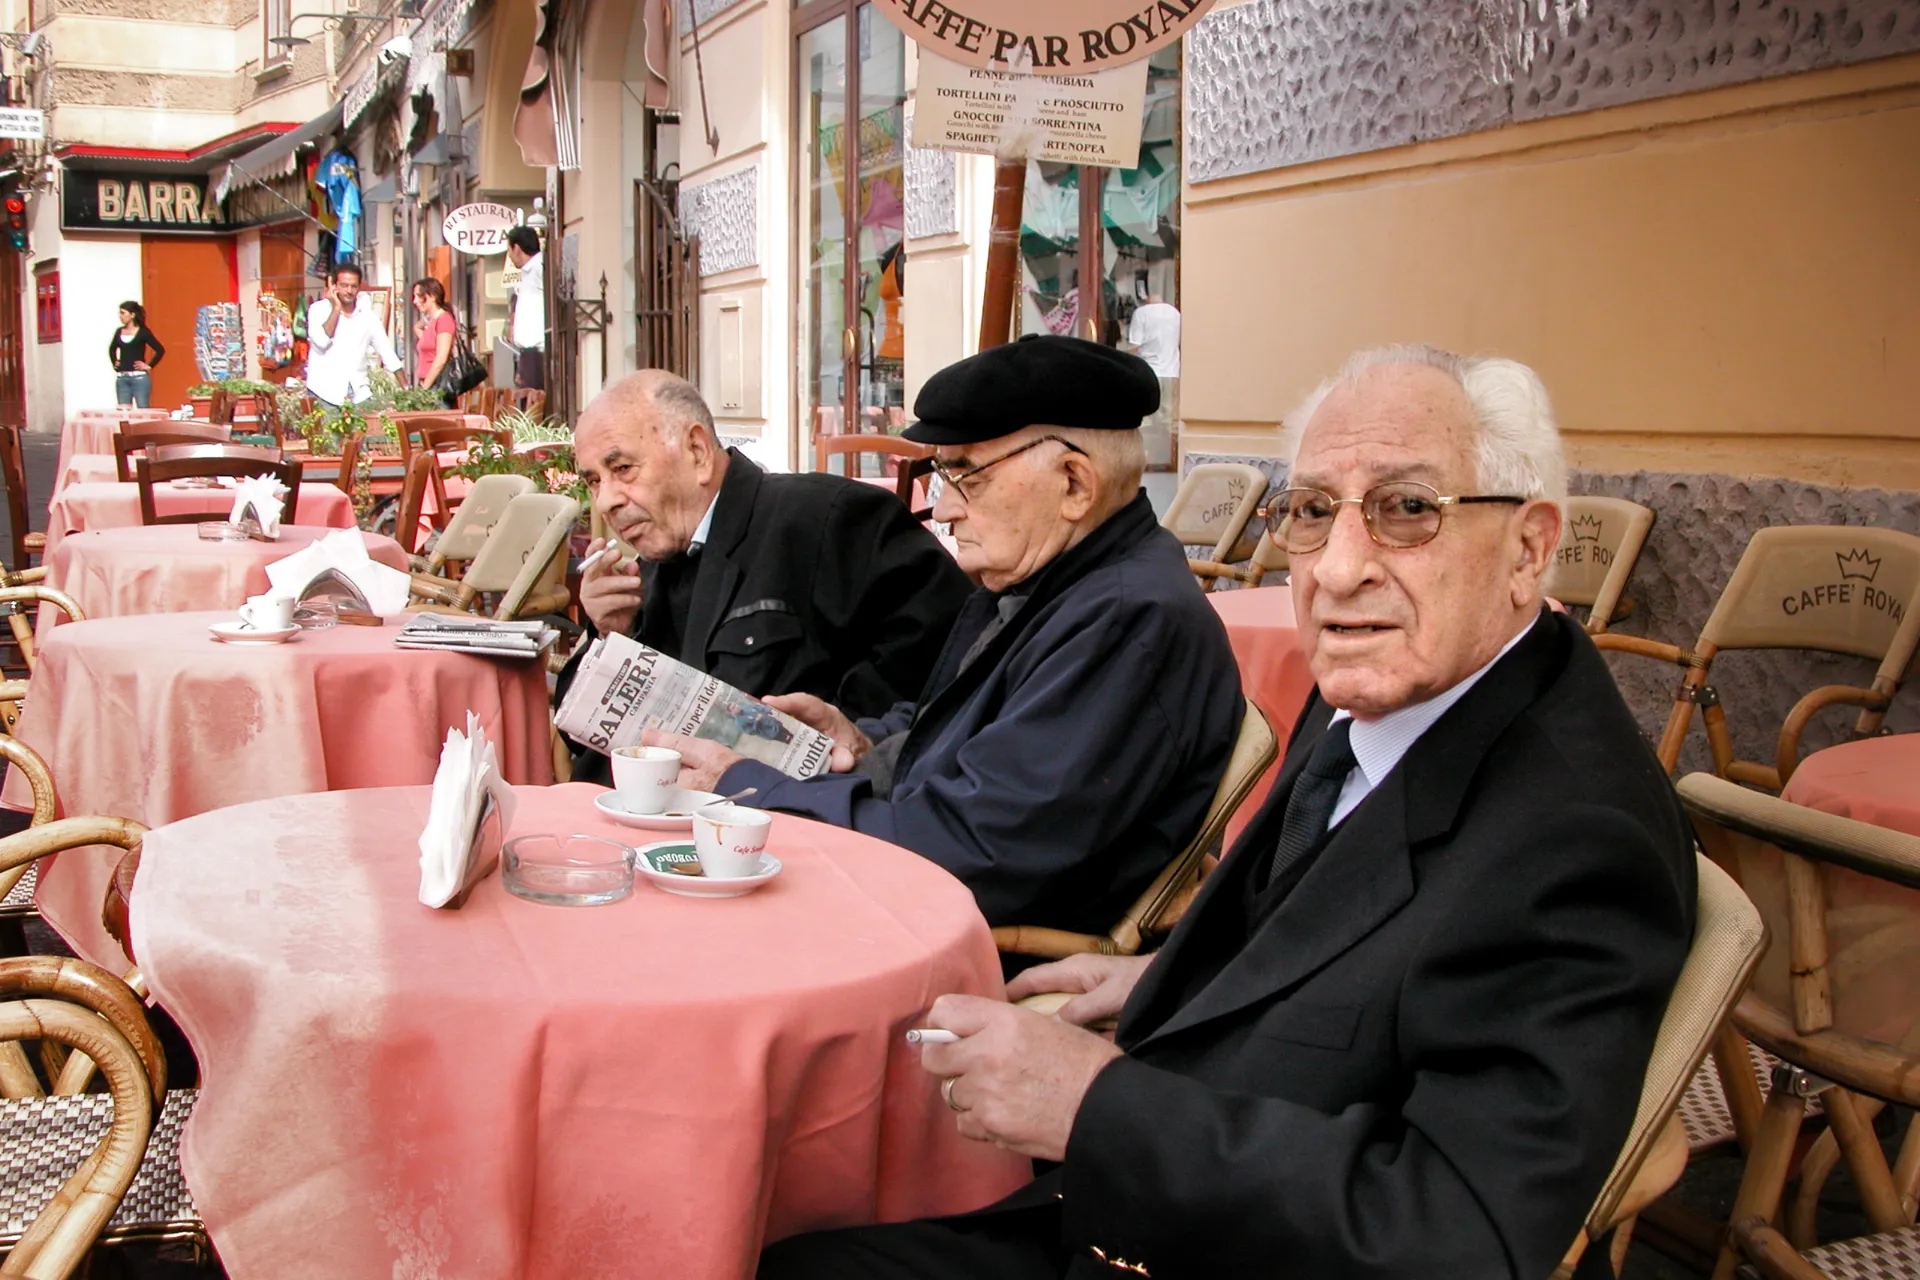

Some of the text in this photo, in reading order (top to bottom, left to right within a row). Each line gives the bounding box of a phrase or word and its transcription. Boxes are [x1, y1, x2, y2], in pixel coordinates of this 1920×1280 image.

[889, 0, 992, 54] AFFE'
[936, 88, 1001, 102] TORTELLINI
[953, 111, 1004, 123] GNOCCHI
[1782, 583, 1855, 616] CAFFE'
[629, 676, 657, 717] CAMPANIA
[697, 694, 710, 705] il
[688, 703, 707, 724] per
